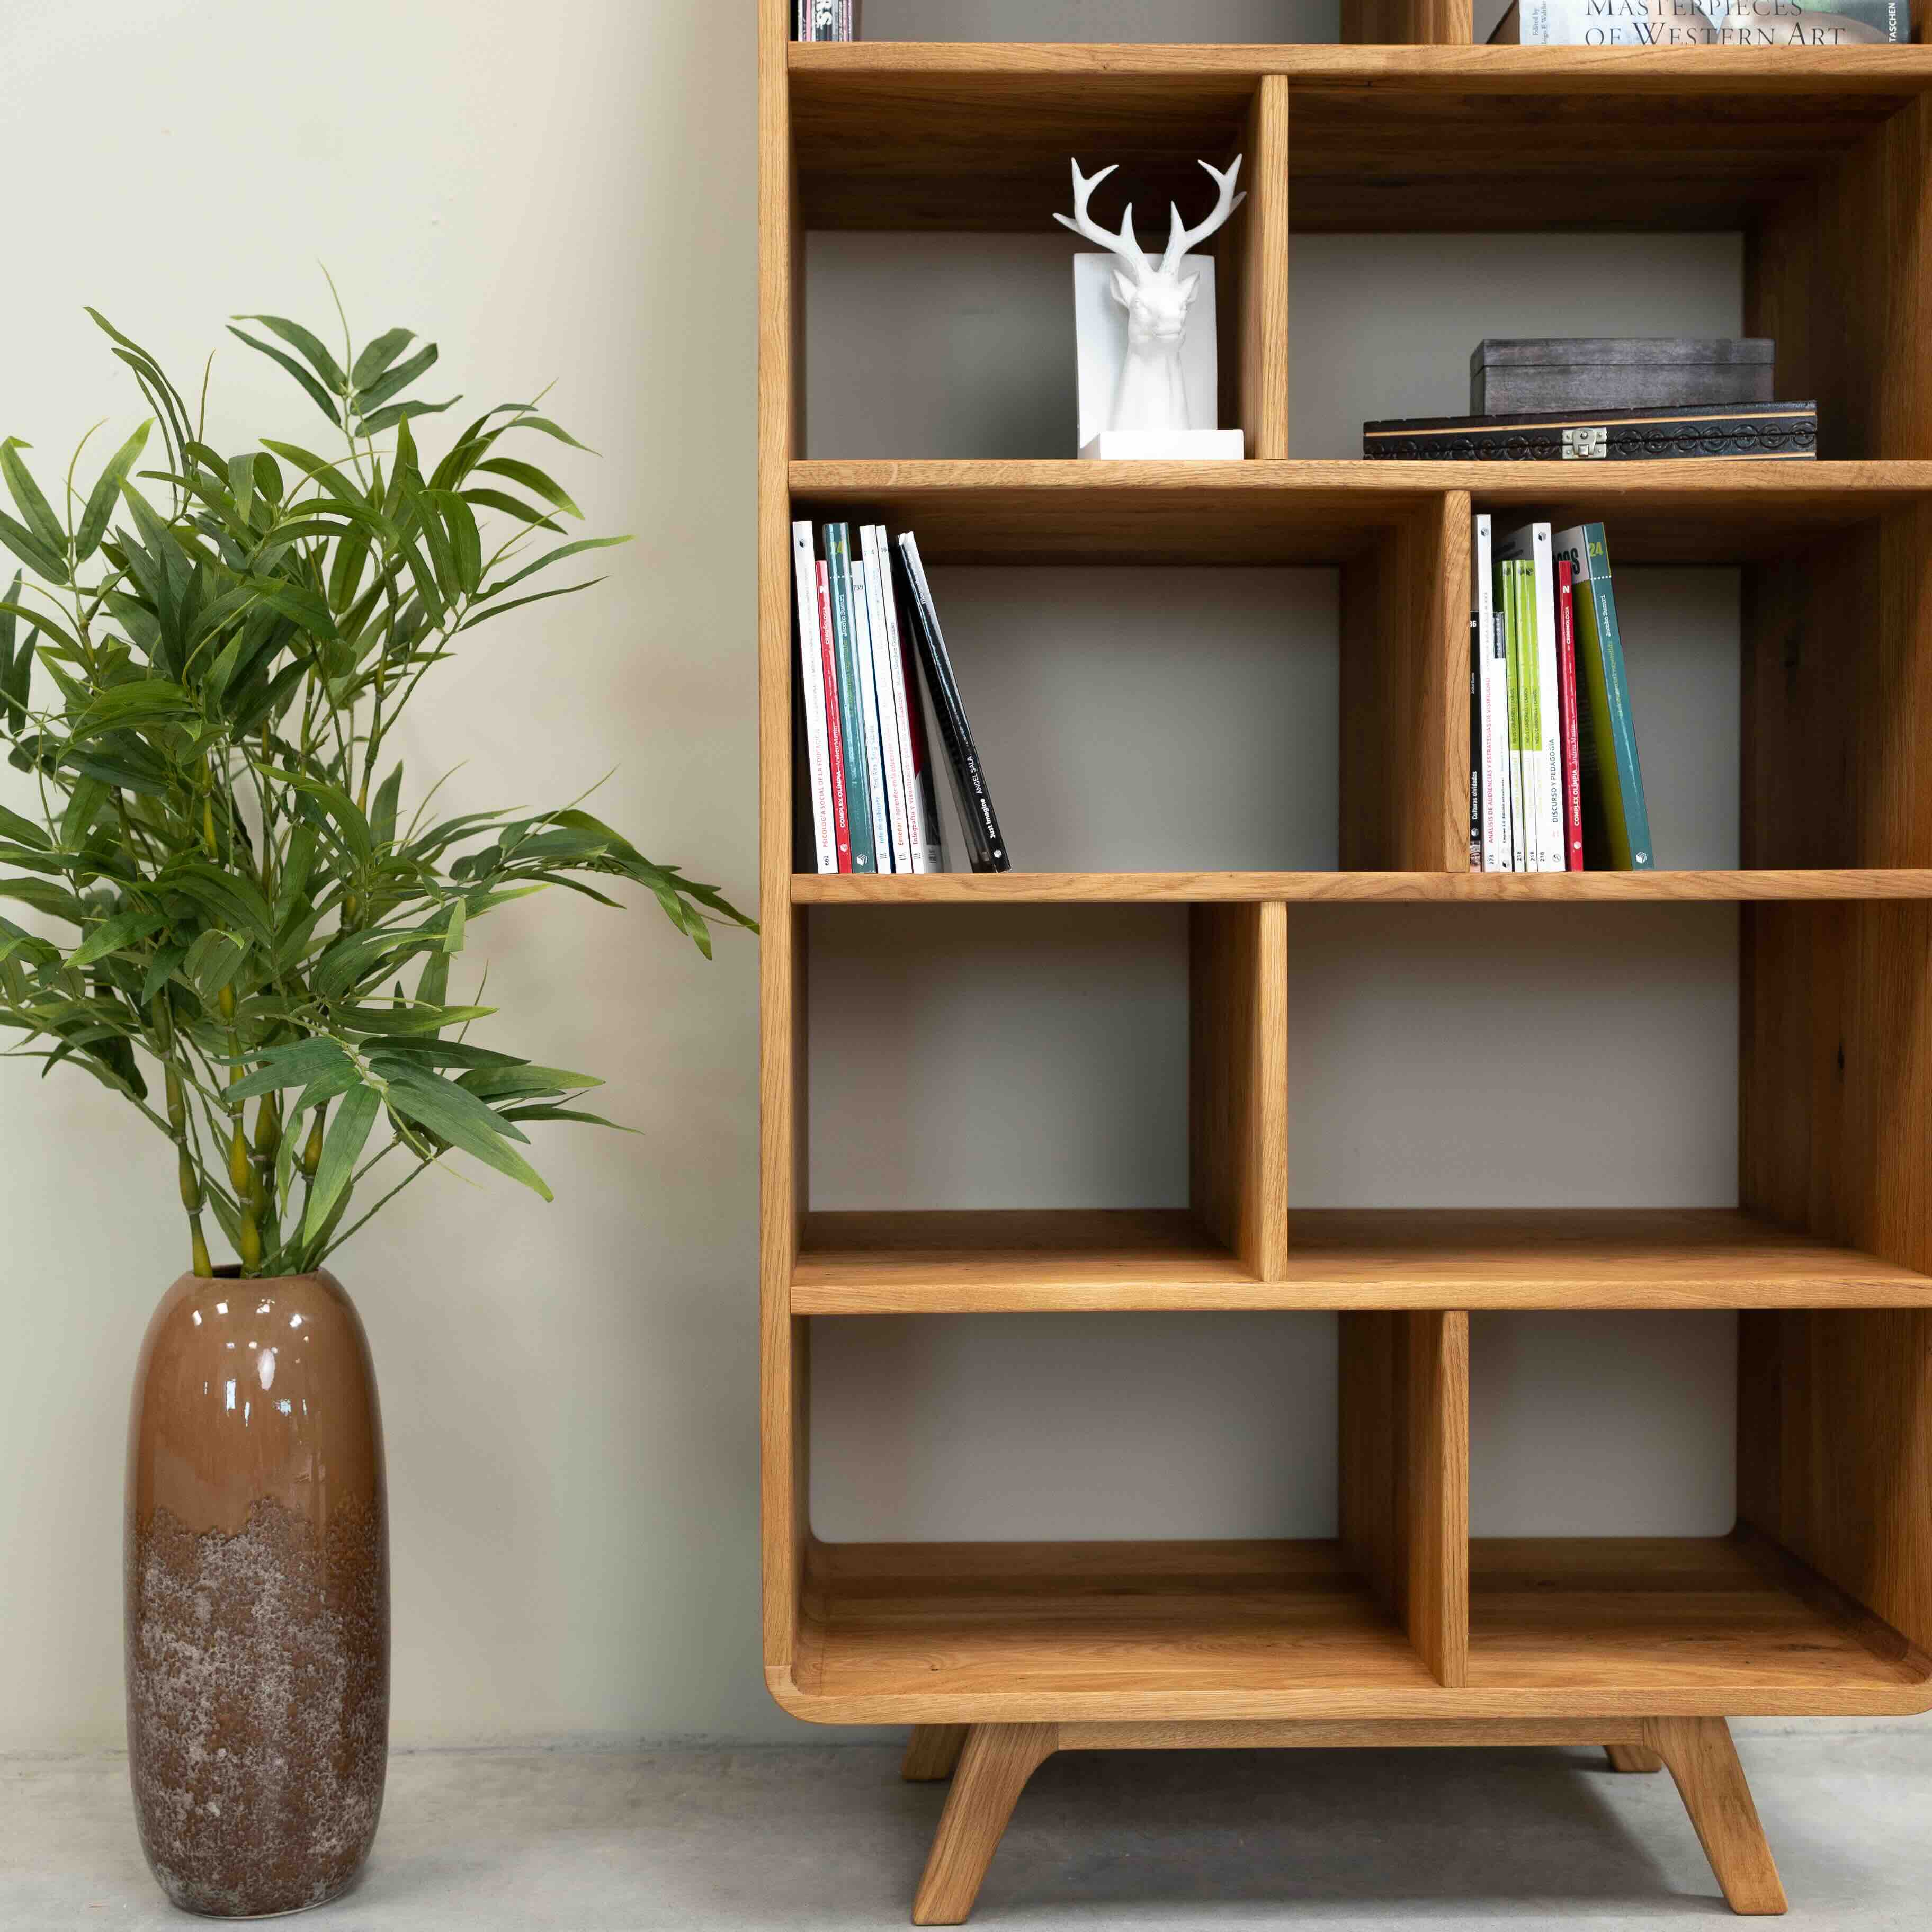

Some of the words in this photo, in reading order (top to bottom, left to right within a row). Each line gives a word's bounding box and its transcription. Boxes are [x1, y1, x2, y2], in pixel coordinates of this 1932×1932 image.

[1585, 0, 1801, 16] MASTERPIECES
[1888, 2, 1897, 43] TASCHEN
[1585, 28, 1621, 45] OF
[1633, 22, 1774, 45] WESTERN
[1788, 22, 1845, 45] ART
[1589, 542, 1604, 557] 24
[968, 755, 976, 773] SALA
[972, 773, 982, 794] ÁNGEL
